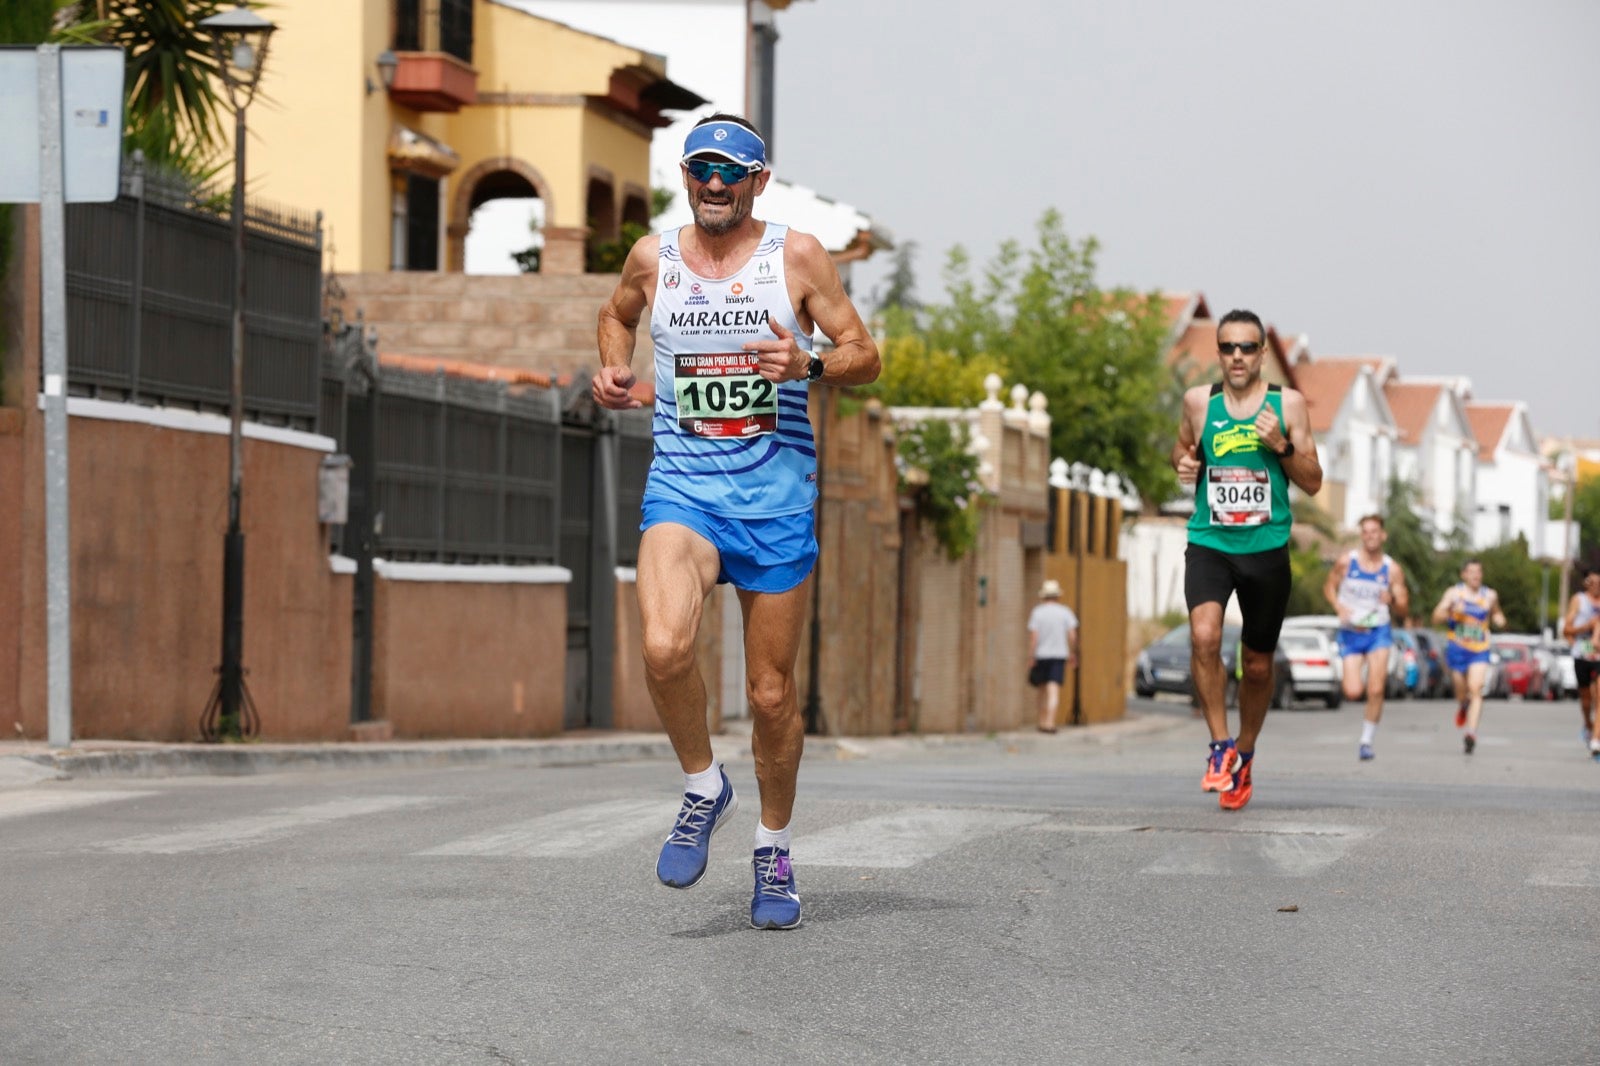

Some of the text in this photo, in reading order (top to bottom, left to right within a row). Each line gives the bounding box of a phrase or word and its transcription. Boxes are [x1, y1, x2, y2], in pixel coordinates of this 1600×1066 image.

[725, 295, 755, 305] mayfo
[670, 309, 769, 327] MARACENA
[697, 356, 713, 367] GRAN
[714, 355, 738, 366] PREMIO
[739, 355, 747, 366] DE
[683, 379, 774, 411] 1052
[1216, 486, 1265, 504] 3046
